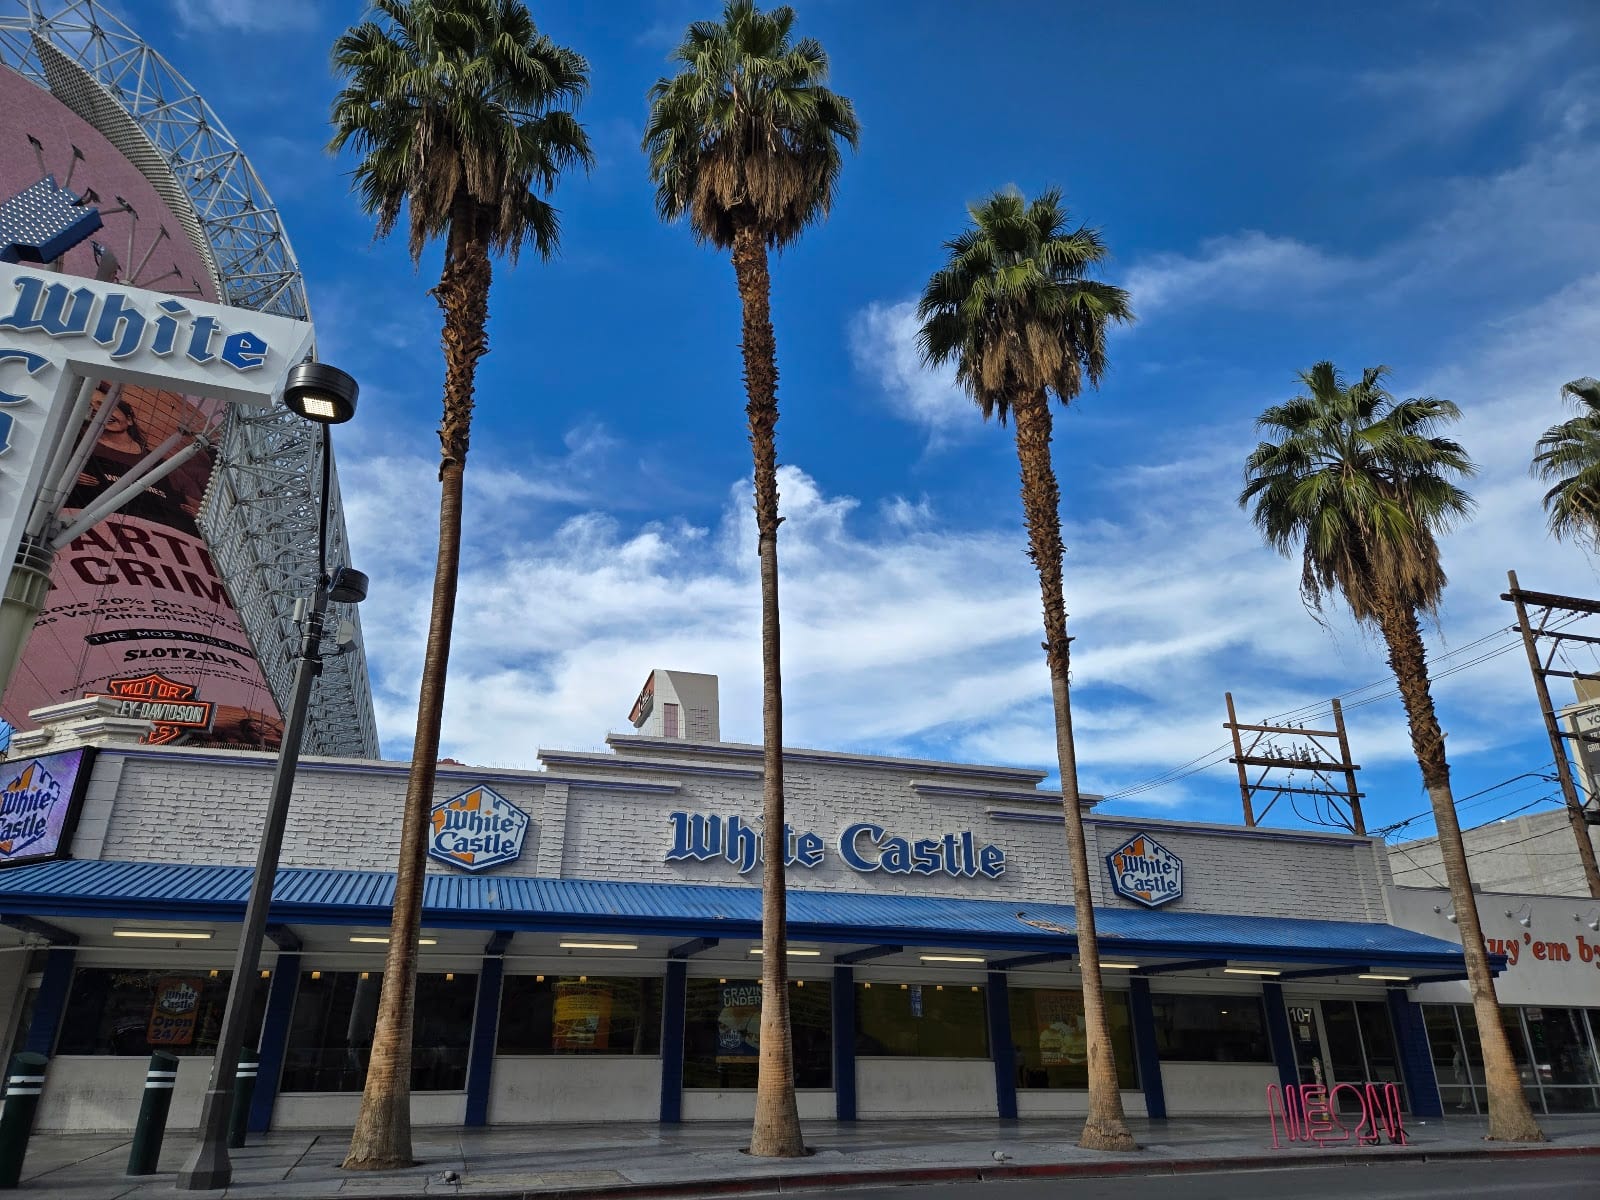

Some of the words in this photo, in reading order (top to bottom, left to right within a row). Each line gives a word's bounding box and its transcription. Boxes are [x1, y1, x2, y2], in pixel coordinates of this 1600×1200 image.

[0, 276, 268, 373] White
[96, 597, 145, 606] 20%
[151, 599, 183, 609] On
[104, 614, 212, 629] Attractions
[91, 632, 128, 642] THE
[181, 633, 253, 655] MUSEUM
[123, 647, 250, 673] SLOTZILLA
[119, 700, 205, 723] EY-DAVIDSON
[0, 788, 52, 820] White
[440, 810, 515, 836] White
[435, 831, 516, 854] Castle
[665, 811, 825, 874] Whte
[837, 822, 1006, 879] Castle
[1122, 855, 1173, 878] White
[1120, 873, 1179, 893] Castle
[1482, 934, 1520, 966] uy
[152, 1016, 193, 1029] Open
[1289, 1007, 1312, 1023] 107
[151, 1028, 190, 1041] 24/7
[1267, 1083, 1407, 1148] NEON
